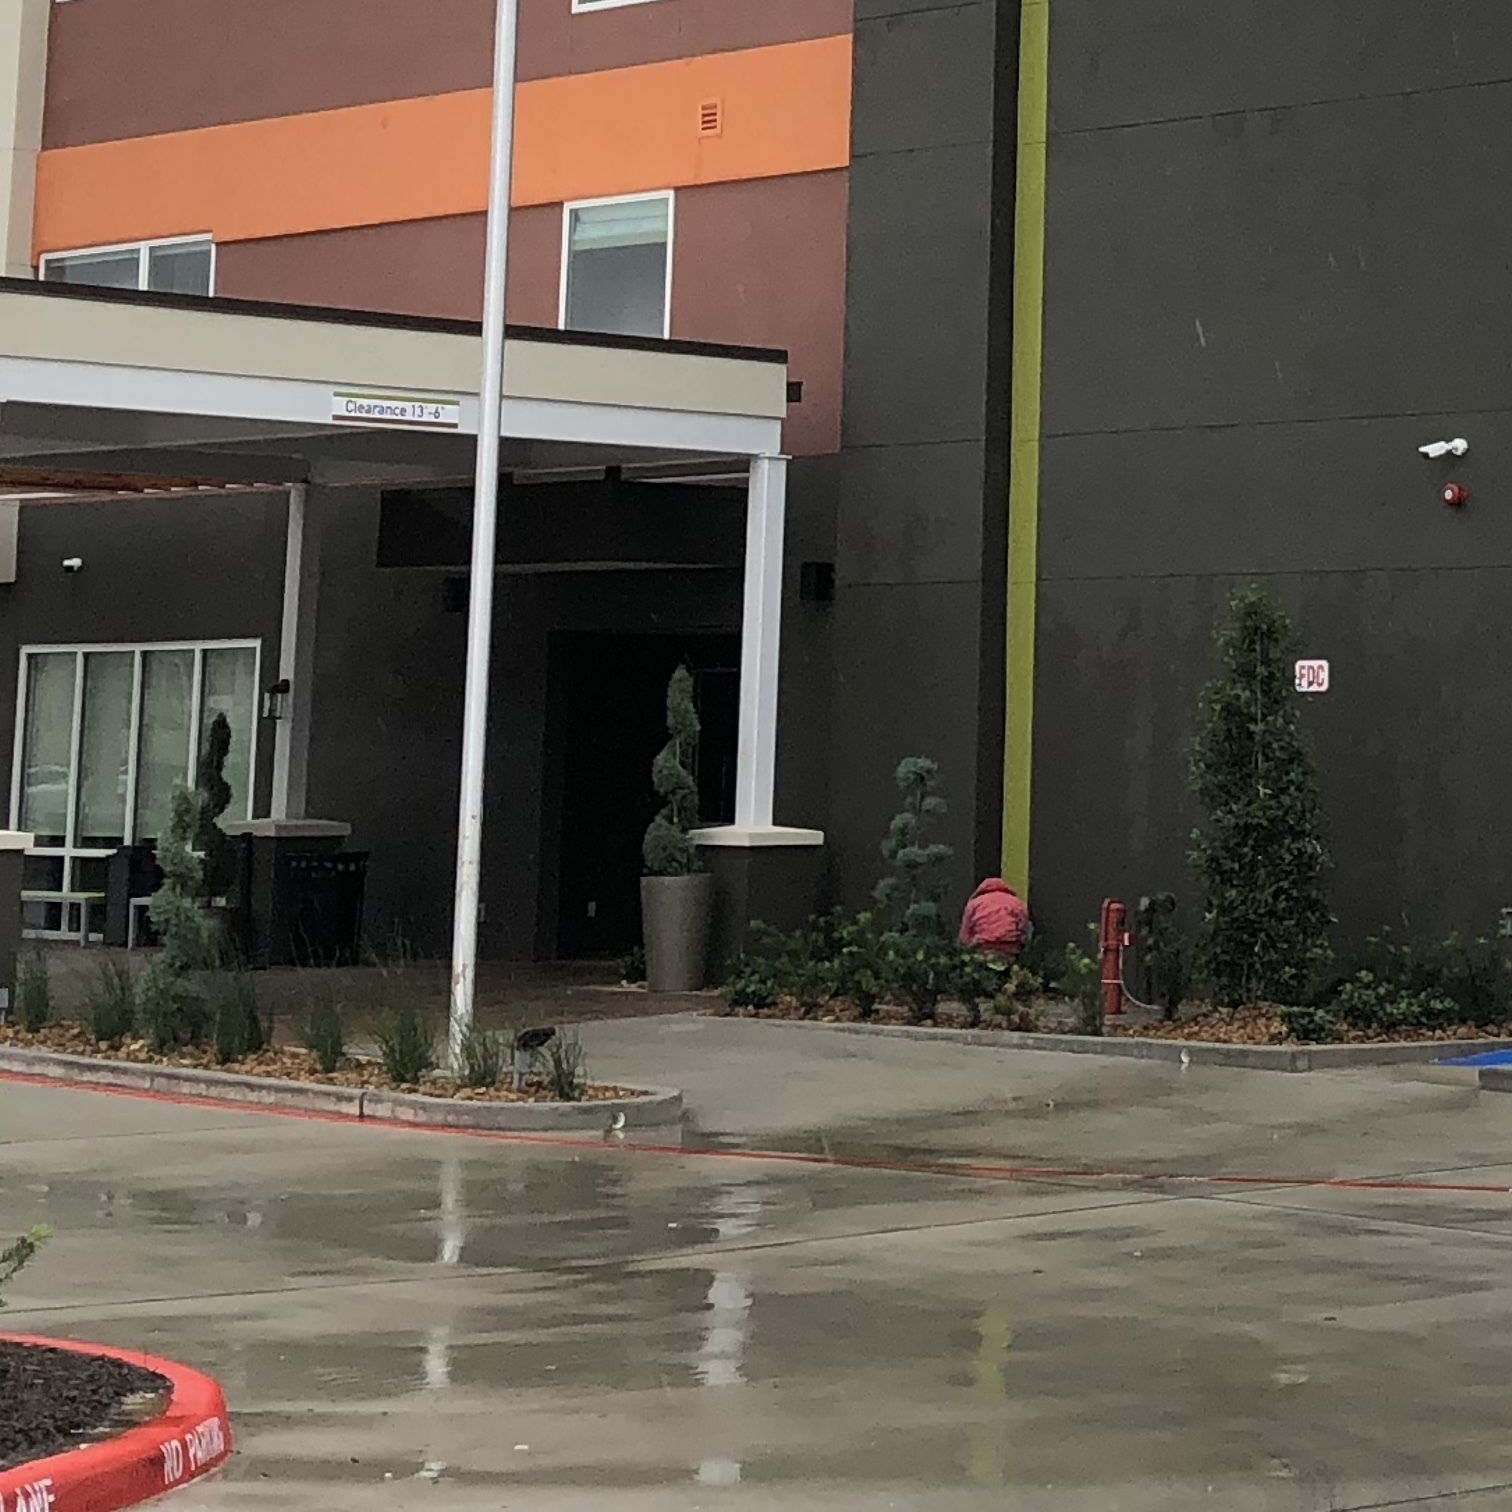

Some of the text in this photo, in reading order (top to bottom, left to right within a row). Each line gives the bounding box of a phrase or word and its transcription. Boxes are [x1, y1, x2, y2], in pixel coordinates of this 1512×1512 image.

[344, 399, 407, 417] Clearance
[1299, 664, 1325, 688] FDC
[160, 1439, 183, 1485] NO
